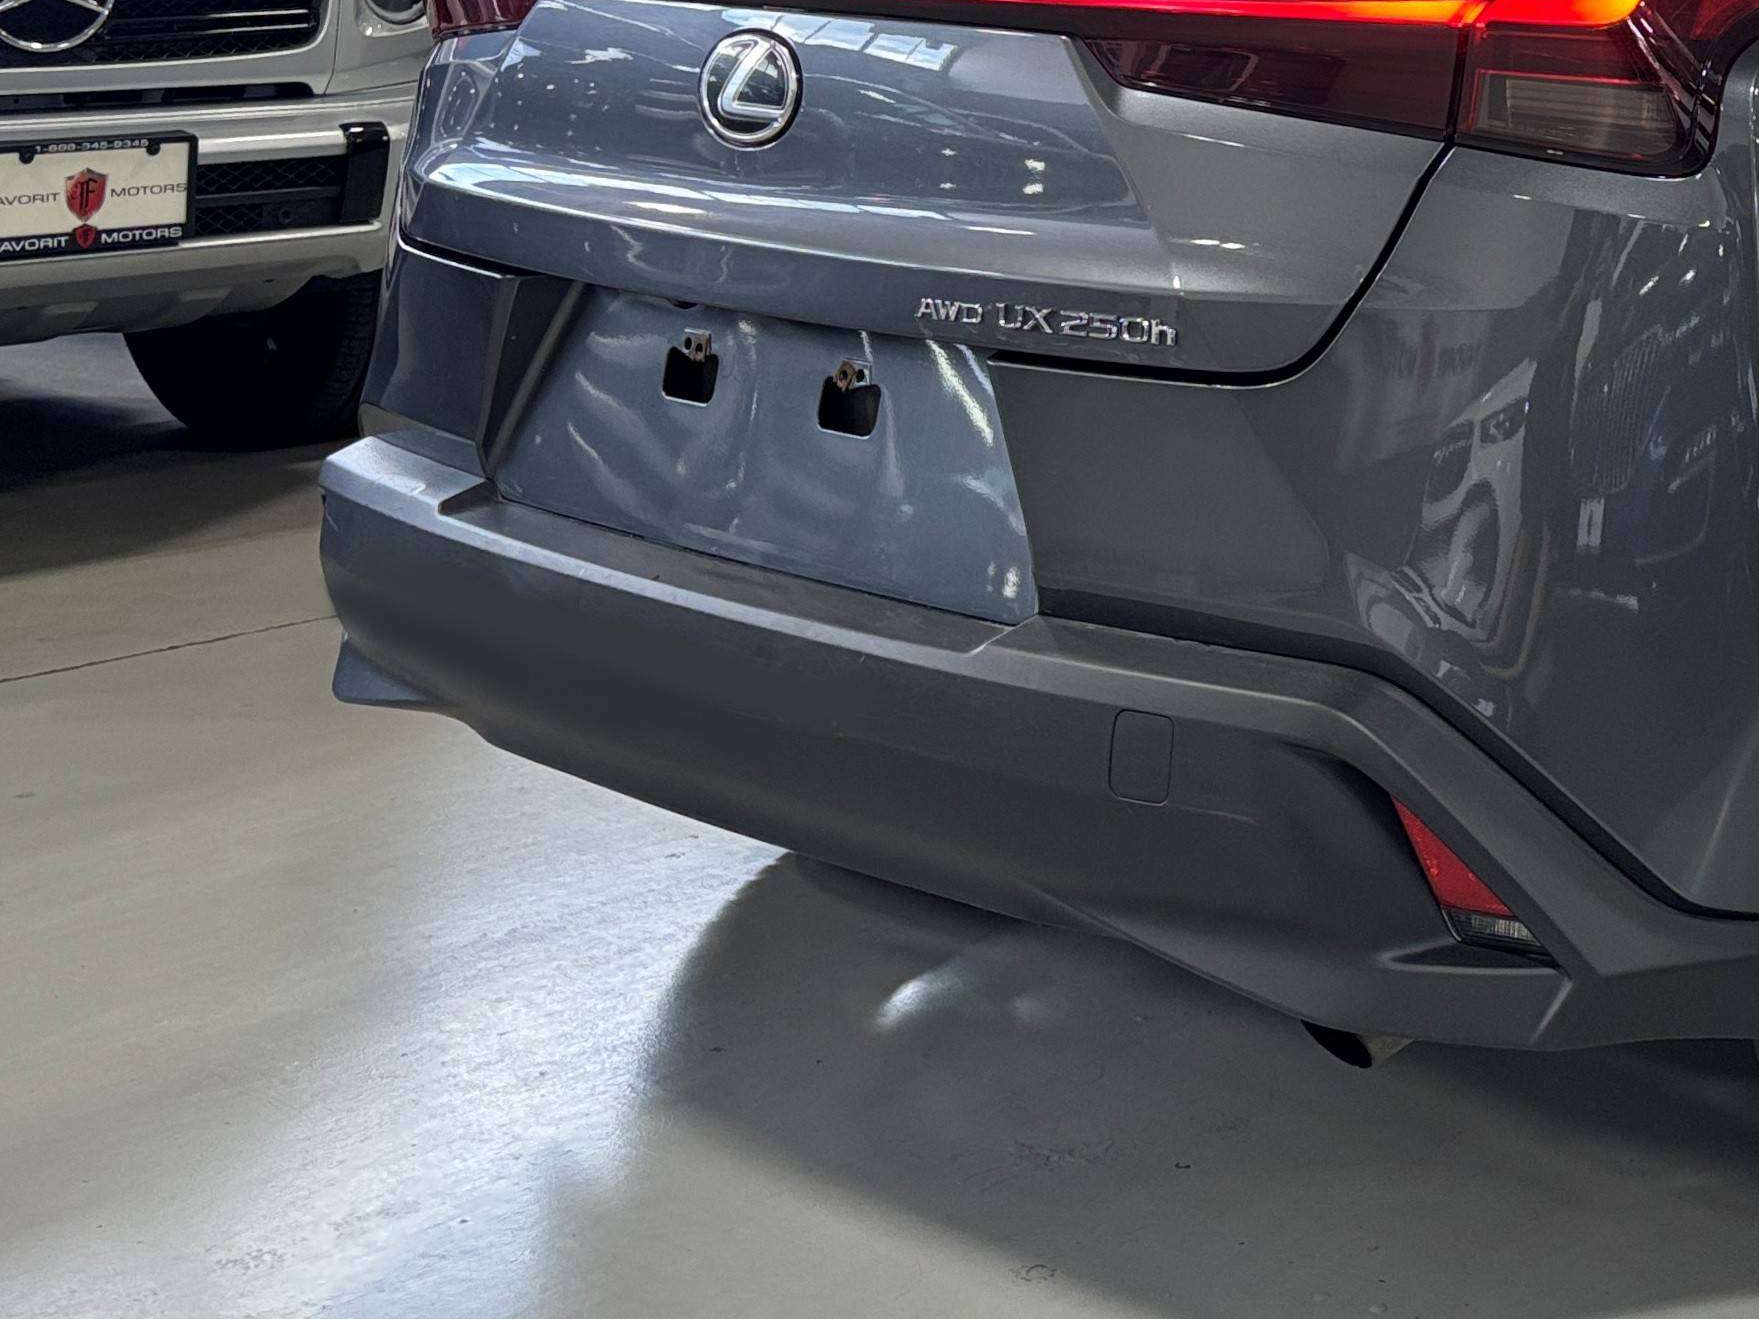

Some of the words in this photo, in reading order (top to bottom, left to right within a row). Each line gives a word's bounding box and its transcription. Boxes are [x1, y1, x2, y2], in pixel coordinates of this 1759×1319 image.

[111, 182, 188, 198] MOTORS
[101, 226, 182, 244] MOTORS
[915, 297, 983, 325] AWD
[996, 302, 1054, 334] UX
[1060, 309, 1177, 347] 250h
